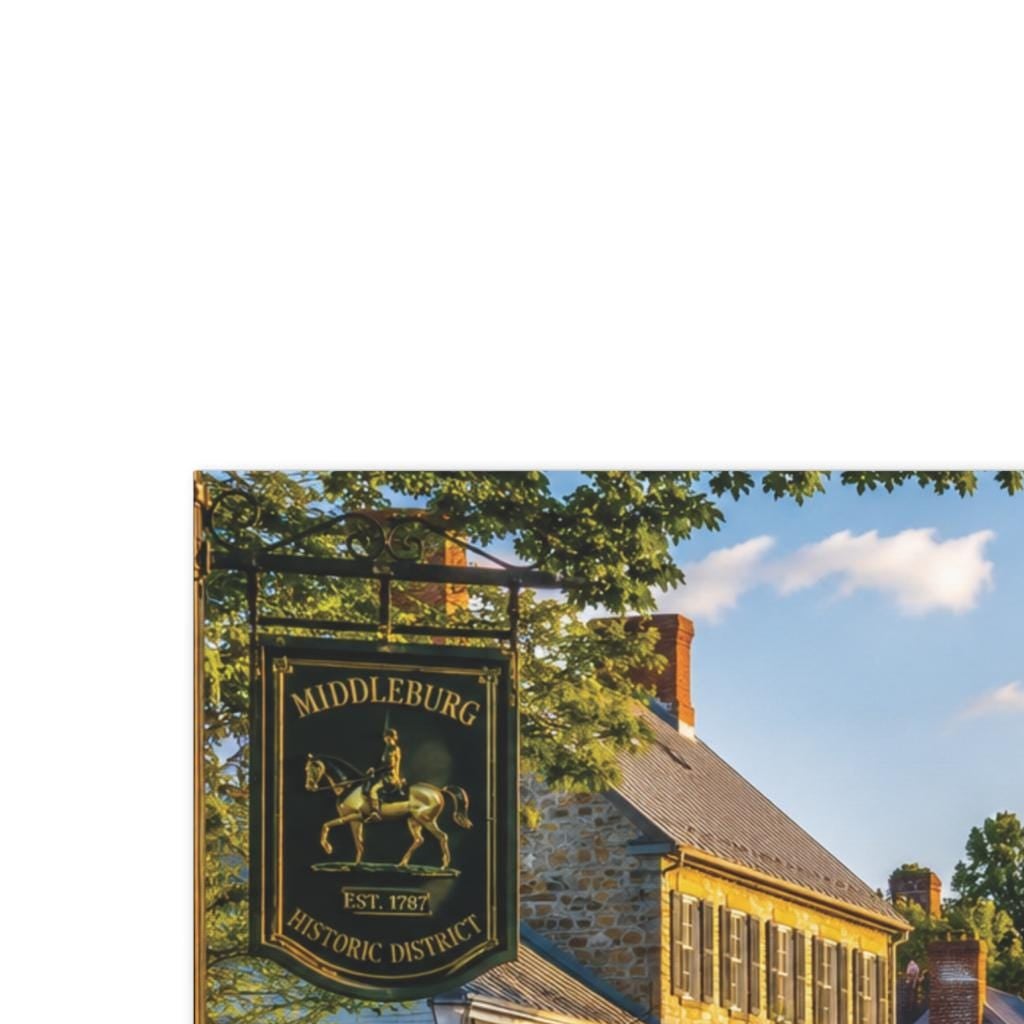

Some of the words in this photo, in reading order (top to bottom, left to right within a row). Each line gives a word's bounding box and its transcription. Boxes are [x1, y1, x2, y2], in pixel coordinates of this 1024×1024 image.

[290, 675, 481, 727] MIDDLEBURG
[343, 892, 384, 910] EST.
[389, 894, 429, 911] 1787
[287, 907, 383, 964] HISTORIC
[390, 913, 482, 964] DISTRICT
